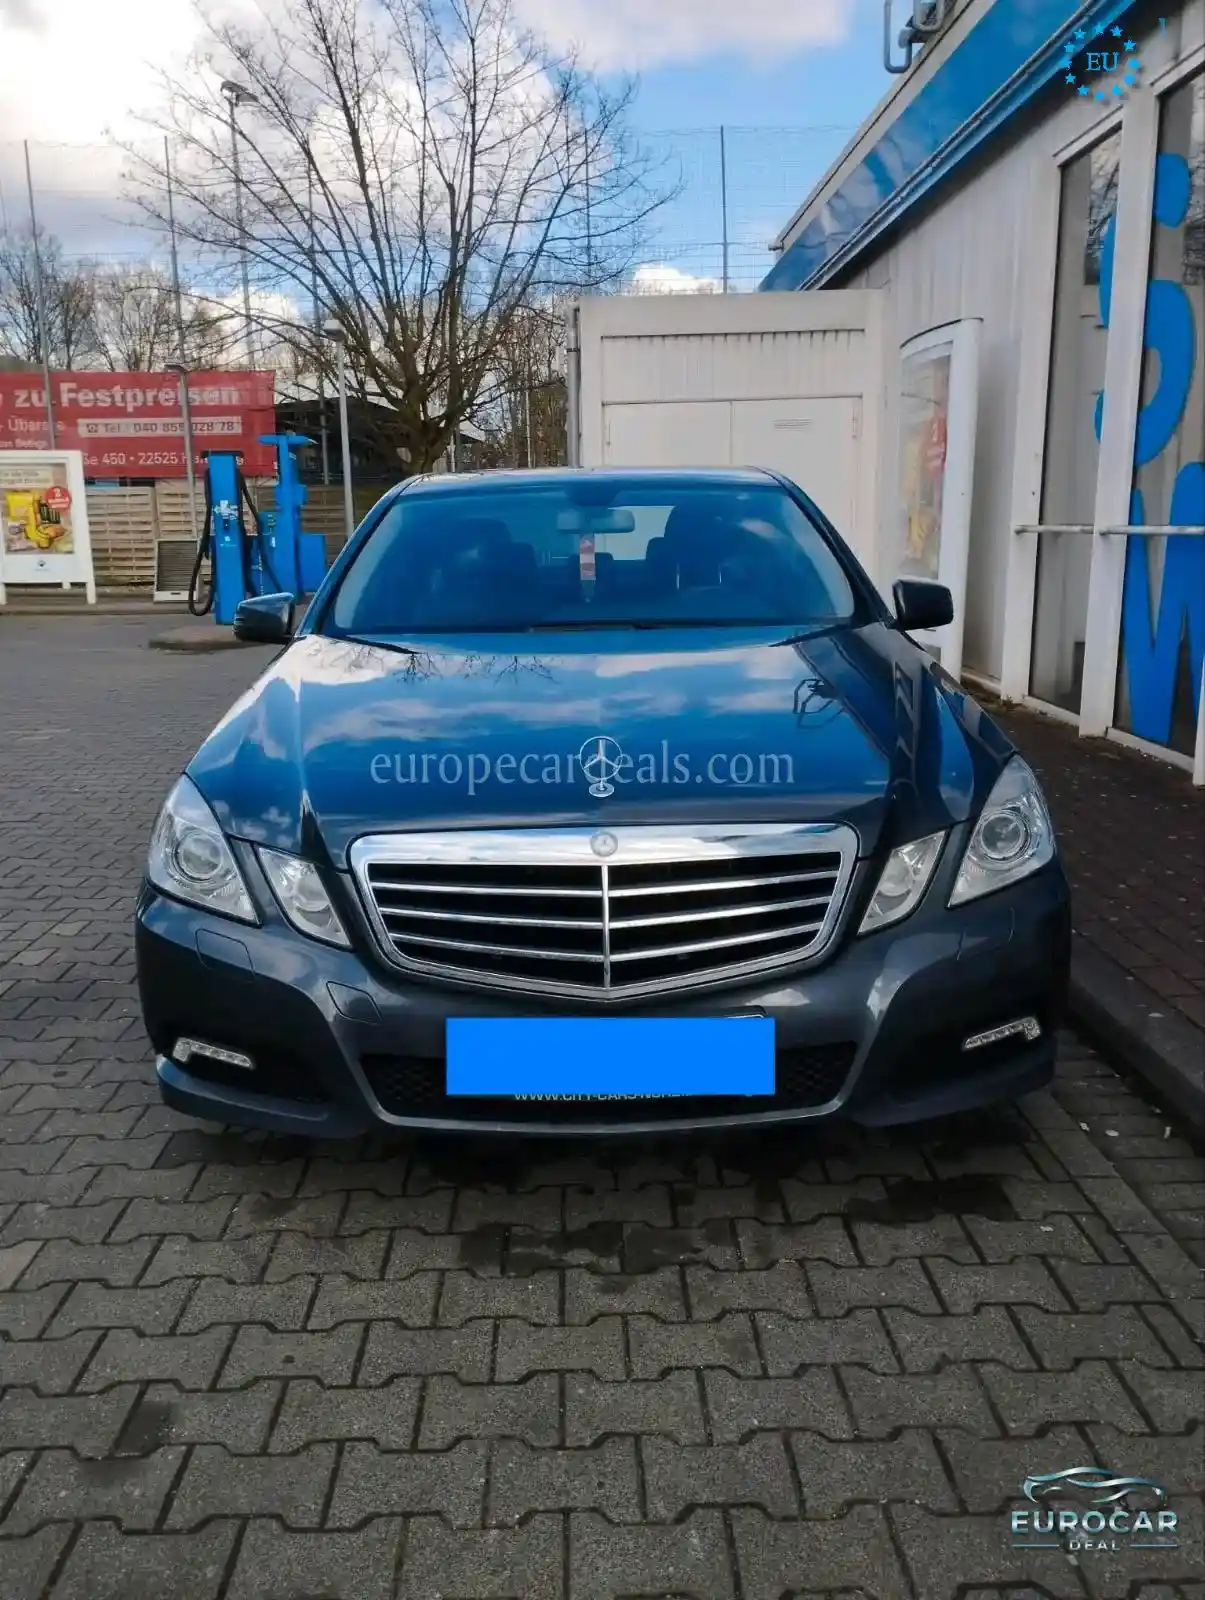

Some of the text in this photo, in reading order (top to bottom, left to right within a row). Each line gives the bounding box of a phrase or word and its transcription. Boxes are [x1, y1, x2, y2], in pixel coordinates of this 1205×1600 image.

[14, 388, 47, 407] zu
[60, 382, 240, 412] Festpreisen
[134, 421, 158, 433] 040
[220, 420, 235, 432] 78
[138, 452, 178, 465] 22525
